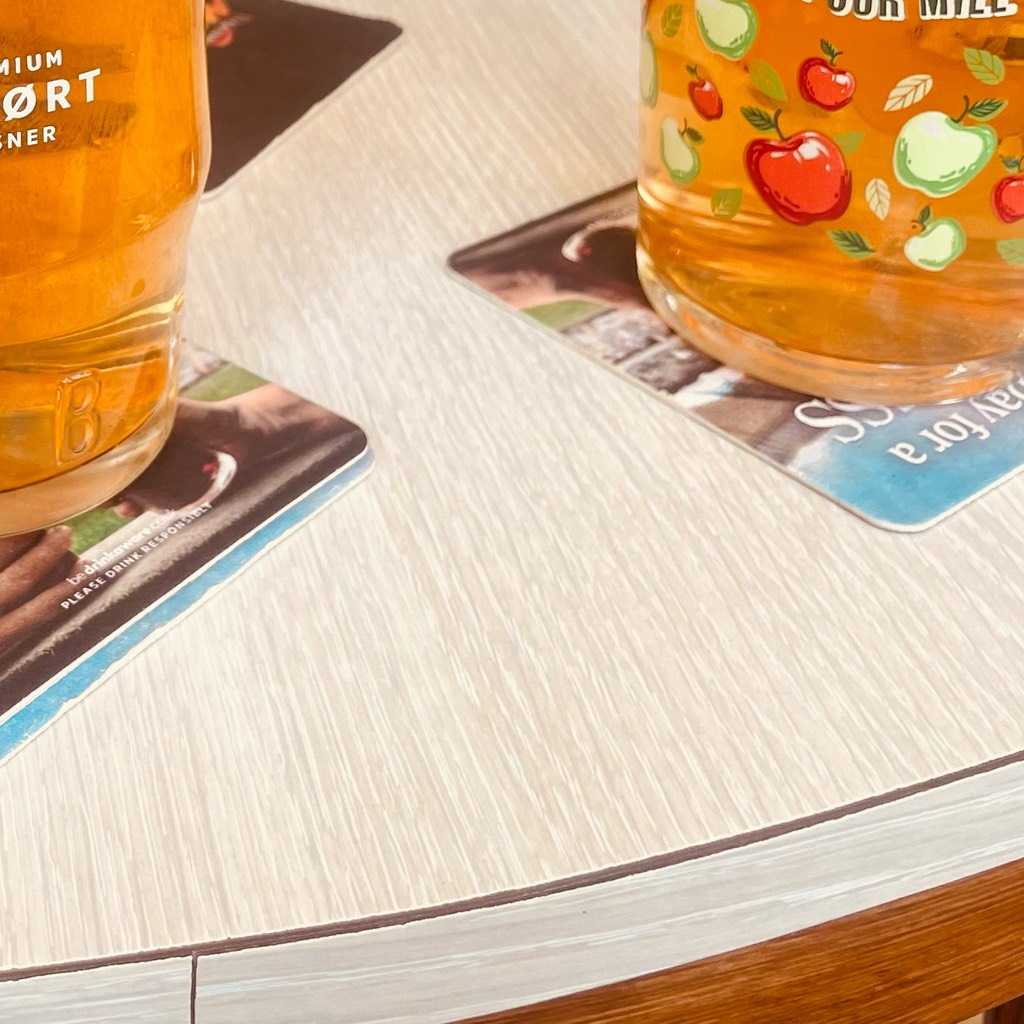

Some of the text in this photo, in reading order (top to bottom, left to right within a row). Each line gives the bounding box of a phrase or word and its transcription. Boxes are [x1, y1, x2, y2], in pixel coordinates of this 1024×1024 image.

[919, 412, 991, 452] for
[887, 440, 928, 465] a
[60, 501, 213, 610] PLEASE DRINK RESPONSIBLY
